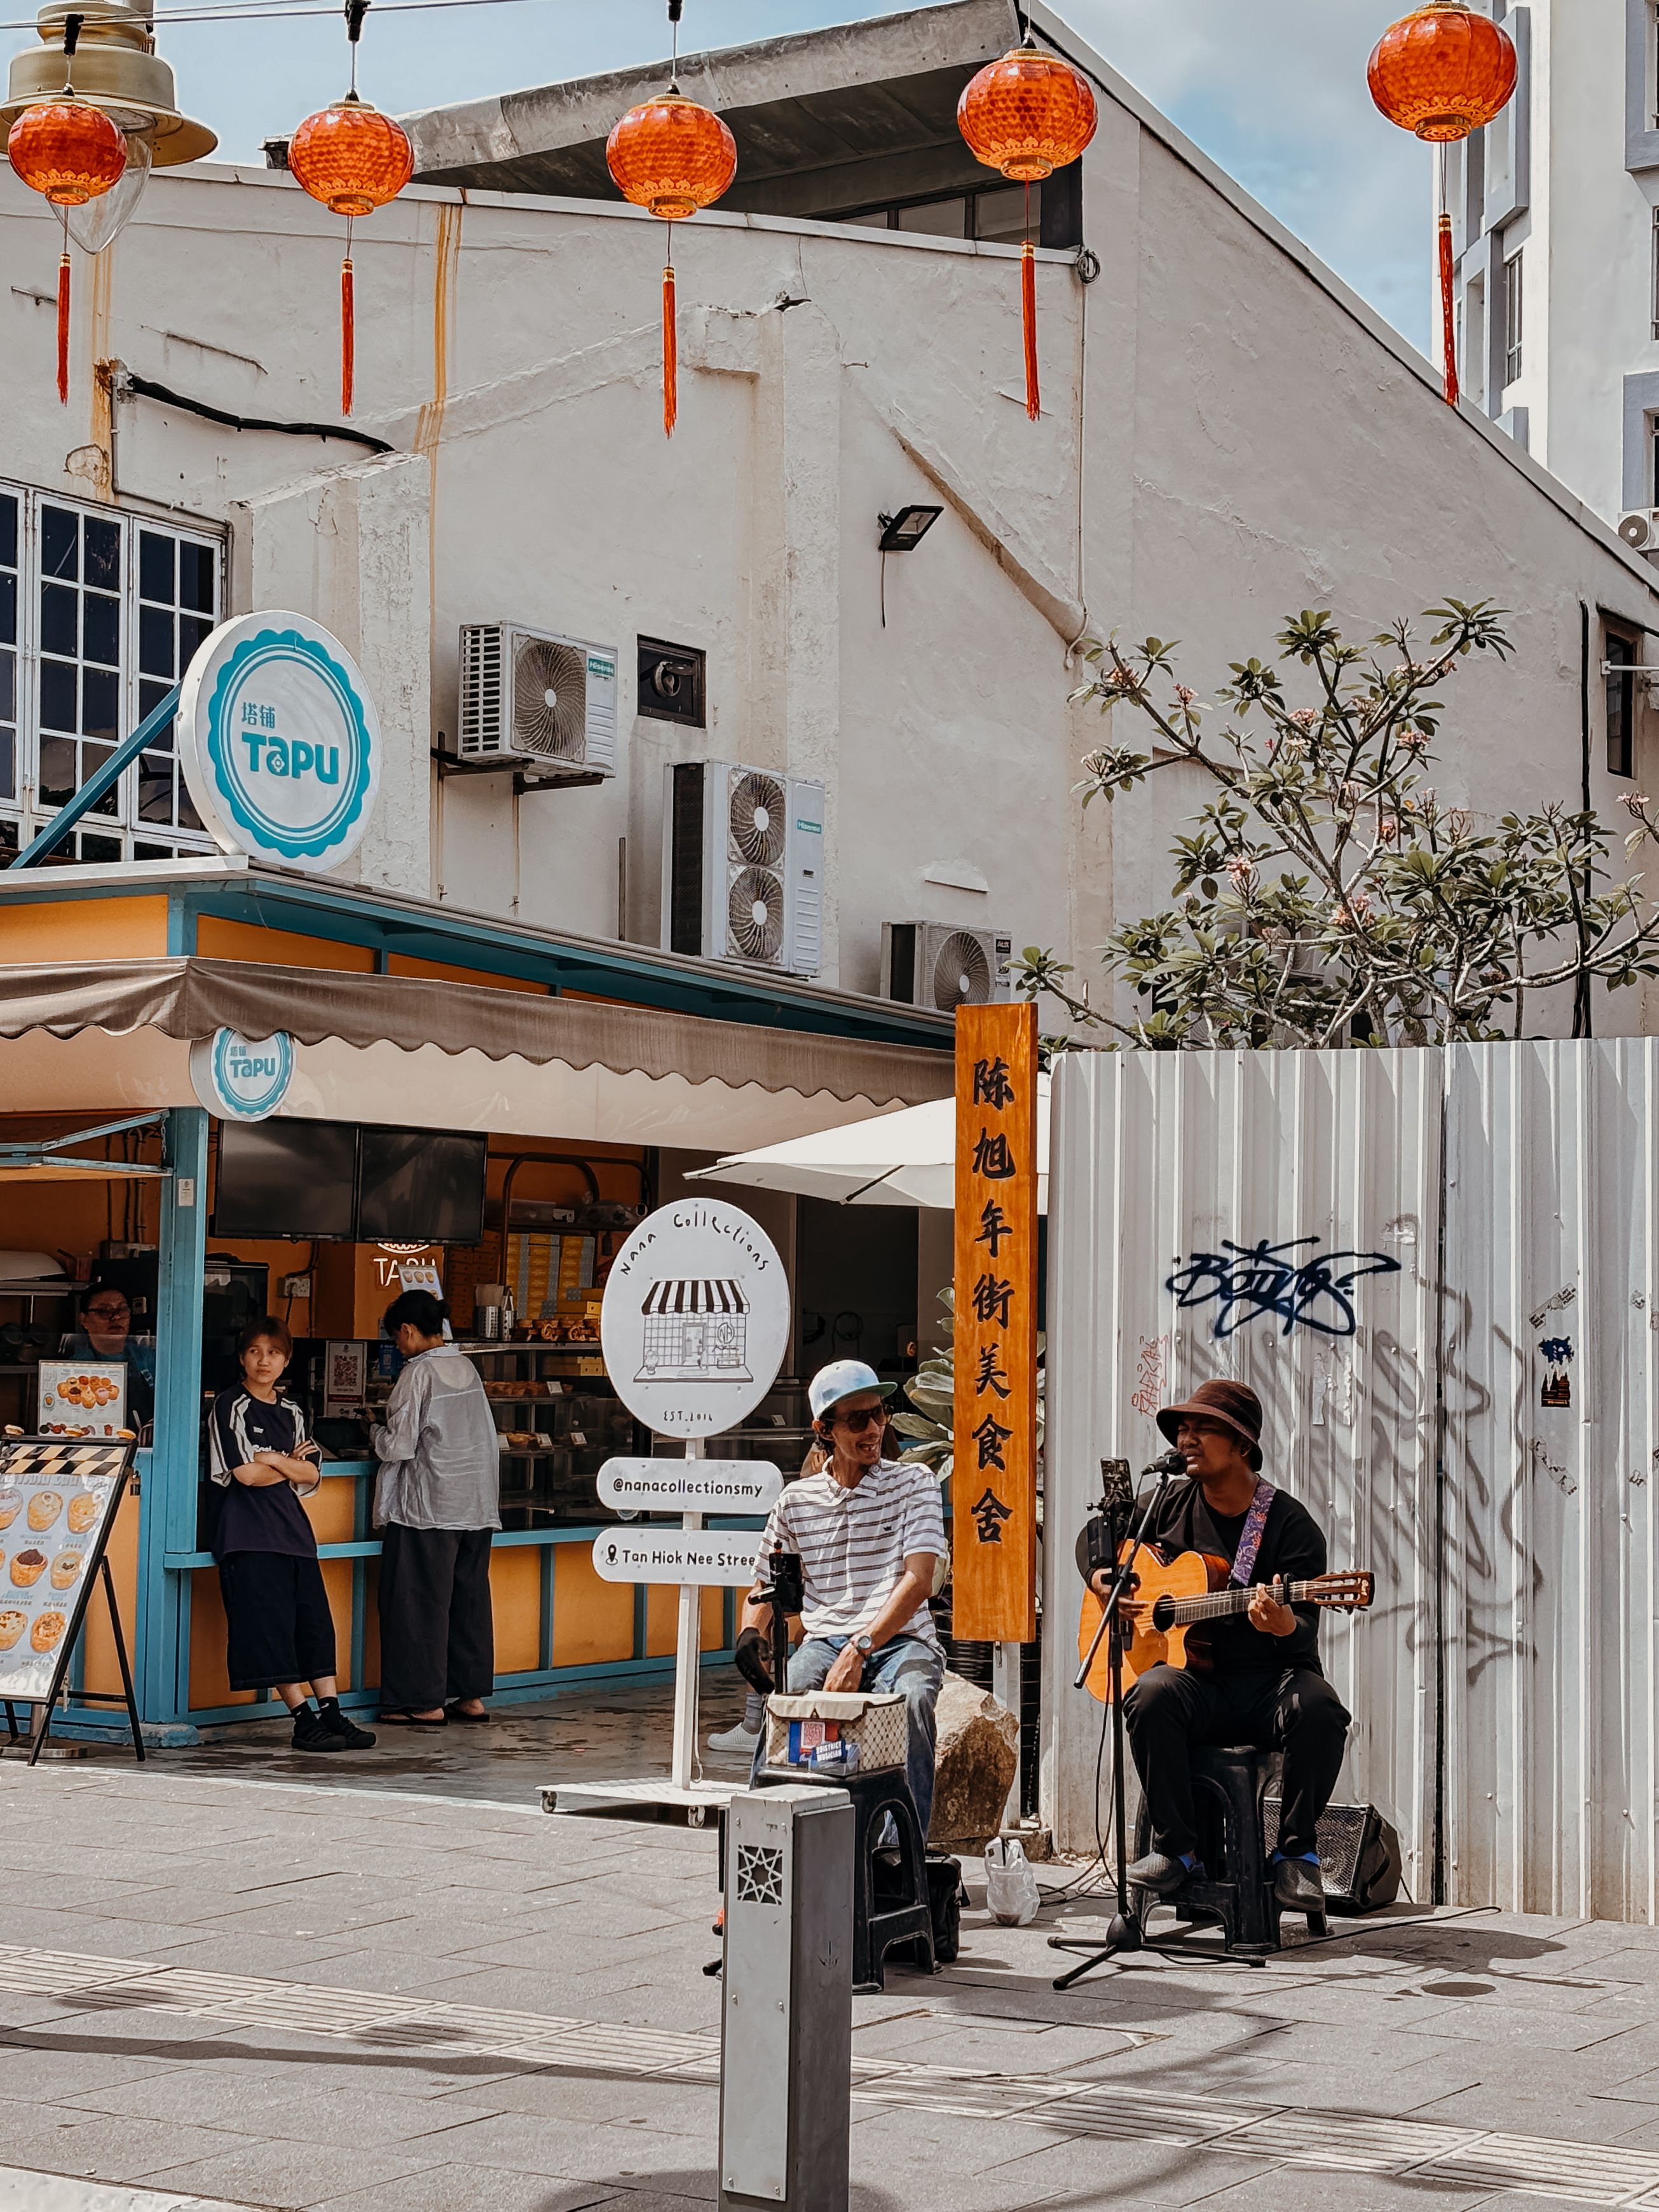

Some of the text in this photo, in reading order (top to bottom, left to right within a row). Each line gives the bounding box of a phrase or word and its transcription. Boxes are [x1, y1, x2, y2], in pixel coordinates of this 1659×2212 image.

[242, 702, 275, 728] 塔铺
[620, 1211, 768, 1275] Nana Collections
[971, 1056, 1016, 1545] 陈旭年街美食舍
[613, 1478, 763, 1498] @nanacollectionsmy
[622, 1550, 755, 1566] Tan Hiok Nee Stree
